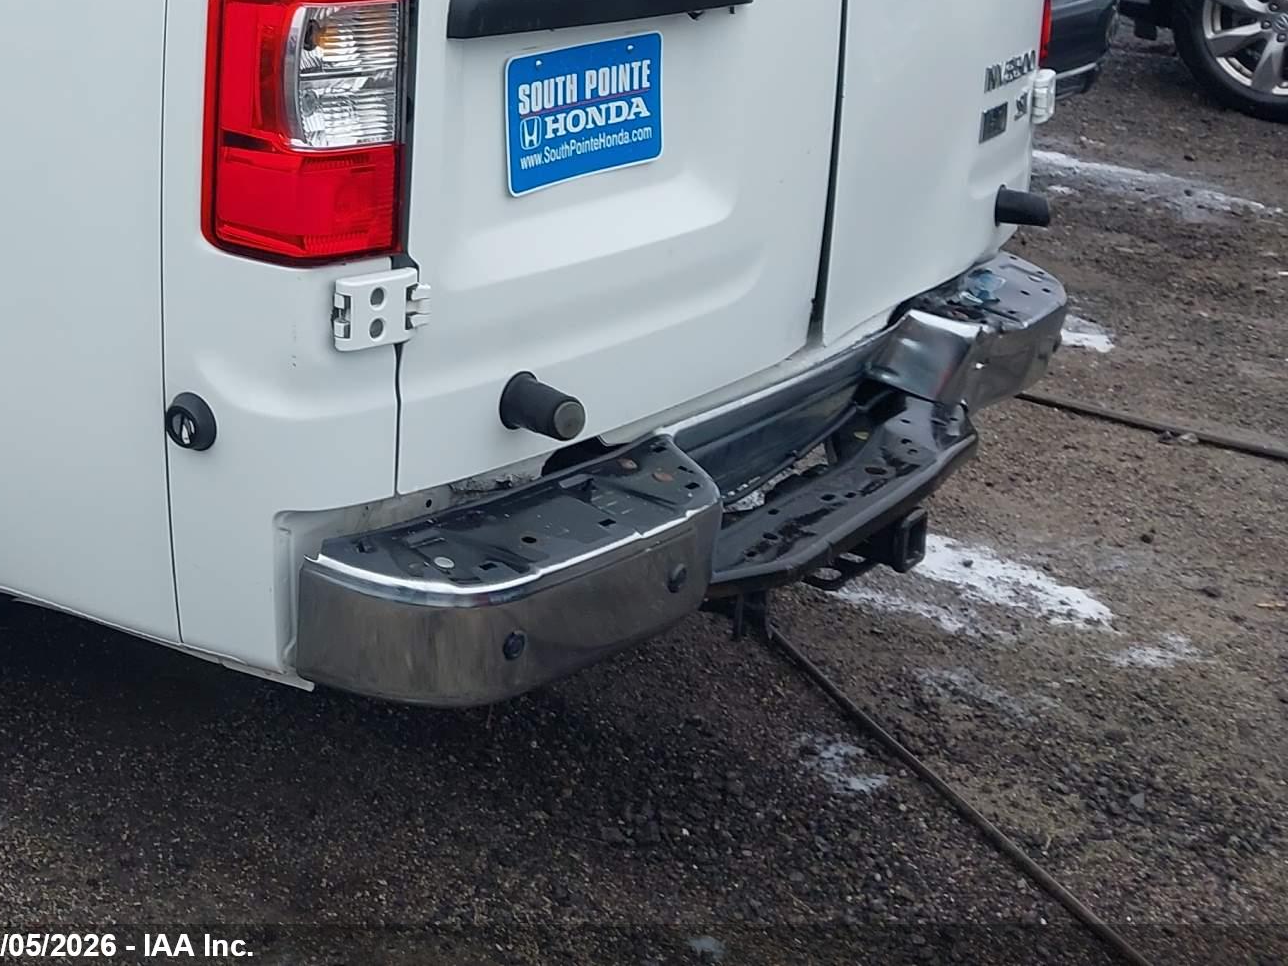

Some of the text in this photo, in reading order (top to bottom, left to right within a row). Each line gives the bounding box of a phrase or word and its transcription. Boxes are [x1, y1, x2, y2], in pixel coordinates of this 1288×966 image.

[518, 59, 651, 115] SOUTH POINTE
[544, 97, 651, 139] HONDA
[520, 126, 652, 170] www.SouthPointeHonda.com
